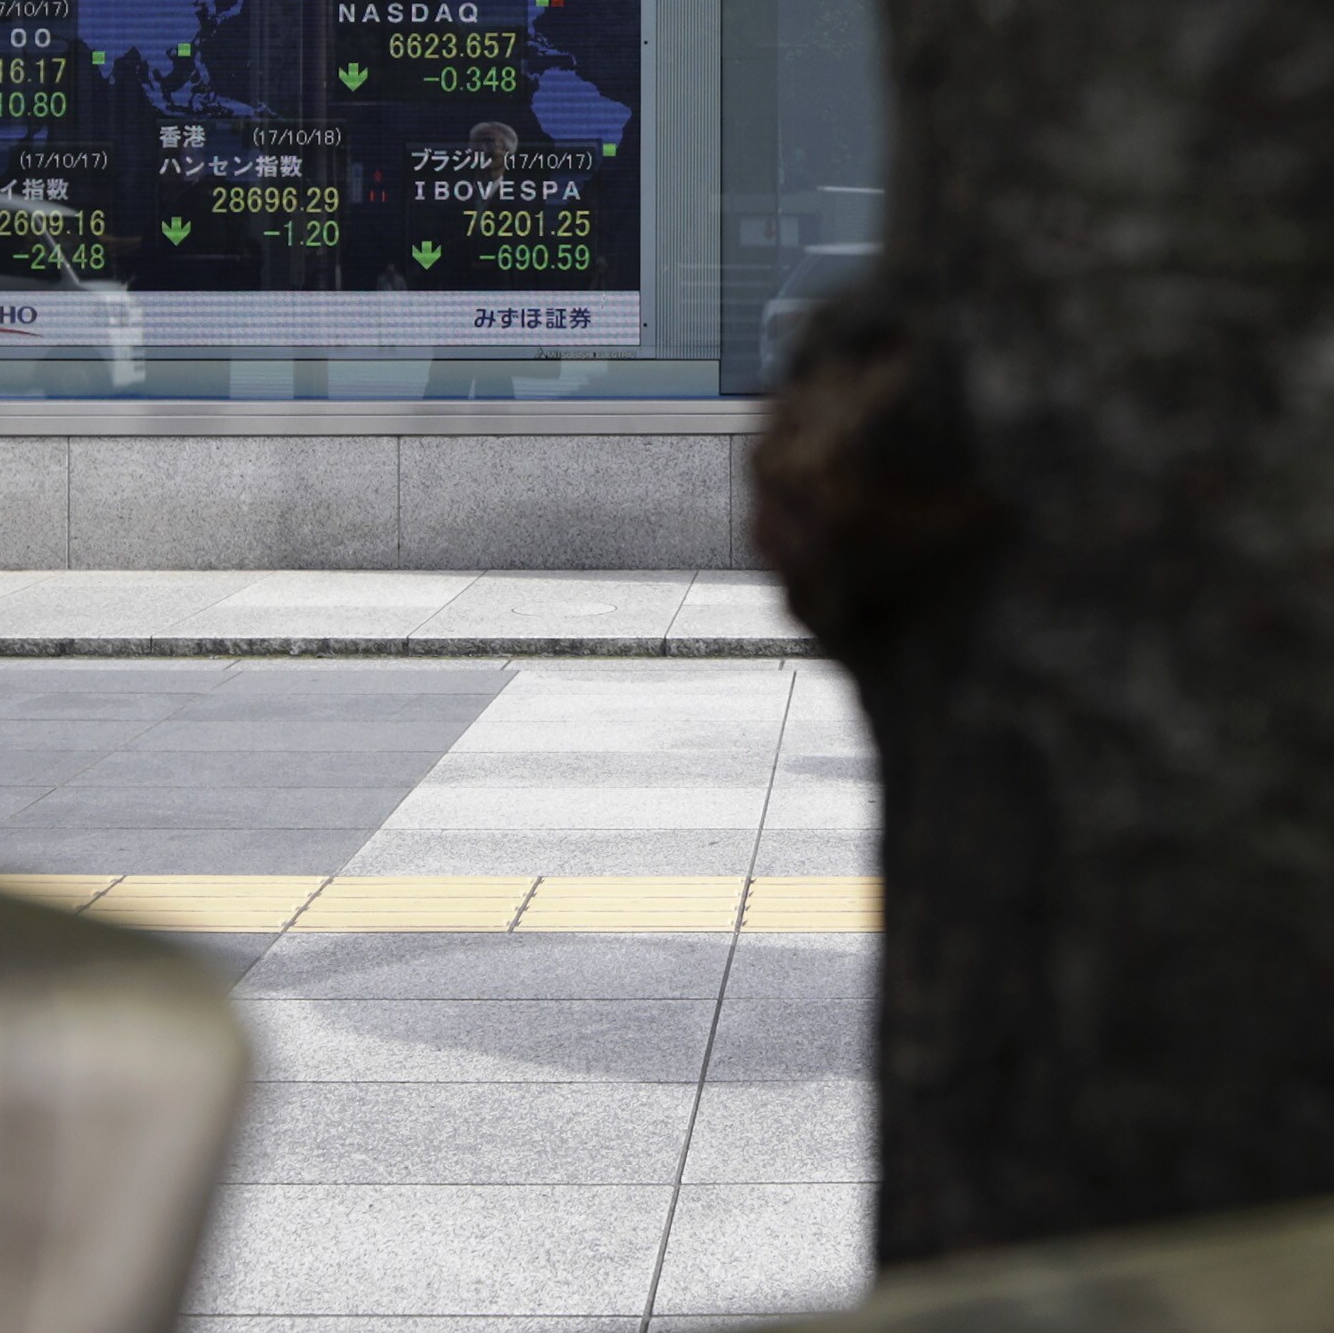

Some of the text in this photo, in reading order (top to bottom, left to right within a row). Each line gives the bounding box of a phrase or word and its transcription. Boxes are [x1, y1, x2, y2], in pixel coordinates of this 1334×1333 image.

[338, 3, 479, 25] NASDAQ
[389, 33, 516, 59] 6623.657
[423, 67, 516, 92] -0.348
[159, 125, 341, 149] 香港 (17/10/18)
[20, 151, 108, 170] (17/10/17)
[159, 155, 303, 178] ハンセン指数
[411, 149, 593, 173] ブラジル (17/10/17)
[212, 186, 340, 213] 28696.29
[415, 180, 582, 202] IBOVESPA
[263, 221, 340, 247] -1.20
[465, 211, 591, 237] 76201.25
[12, 244, 106, 269] -24.48
[479, 244, 591, 270] -690.59
[473, 307, 592, 330] みずほ証券
